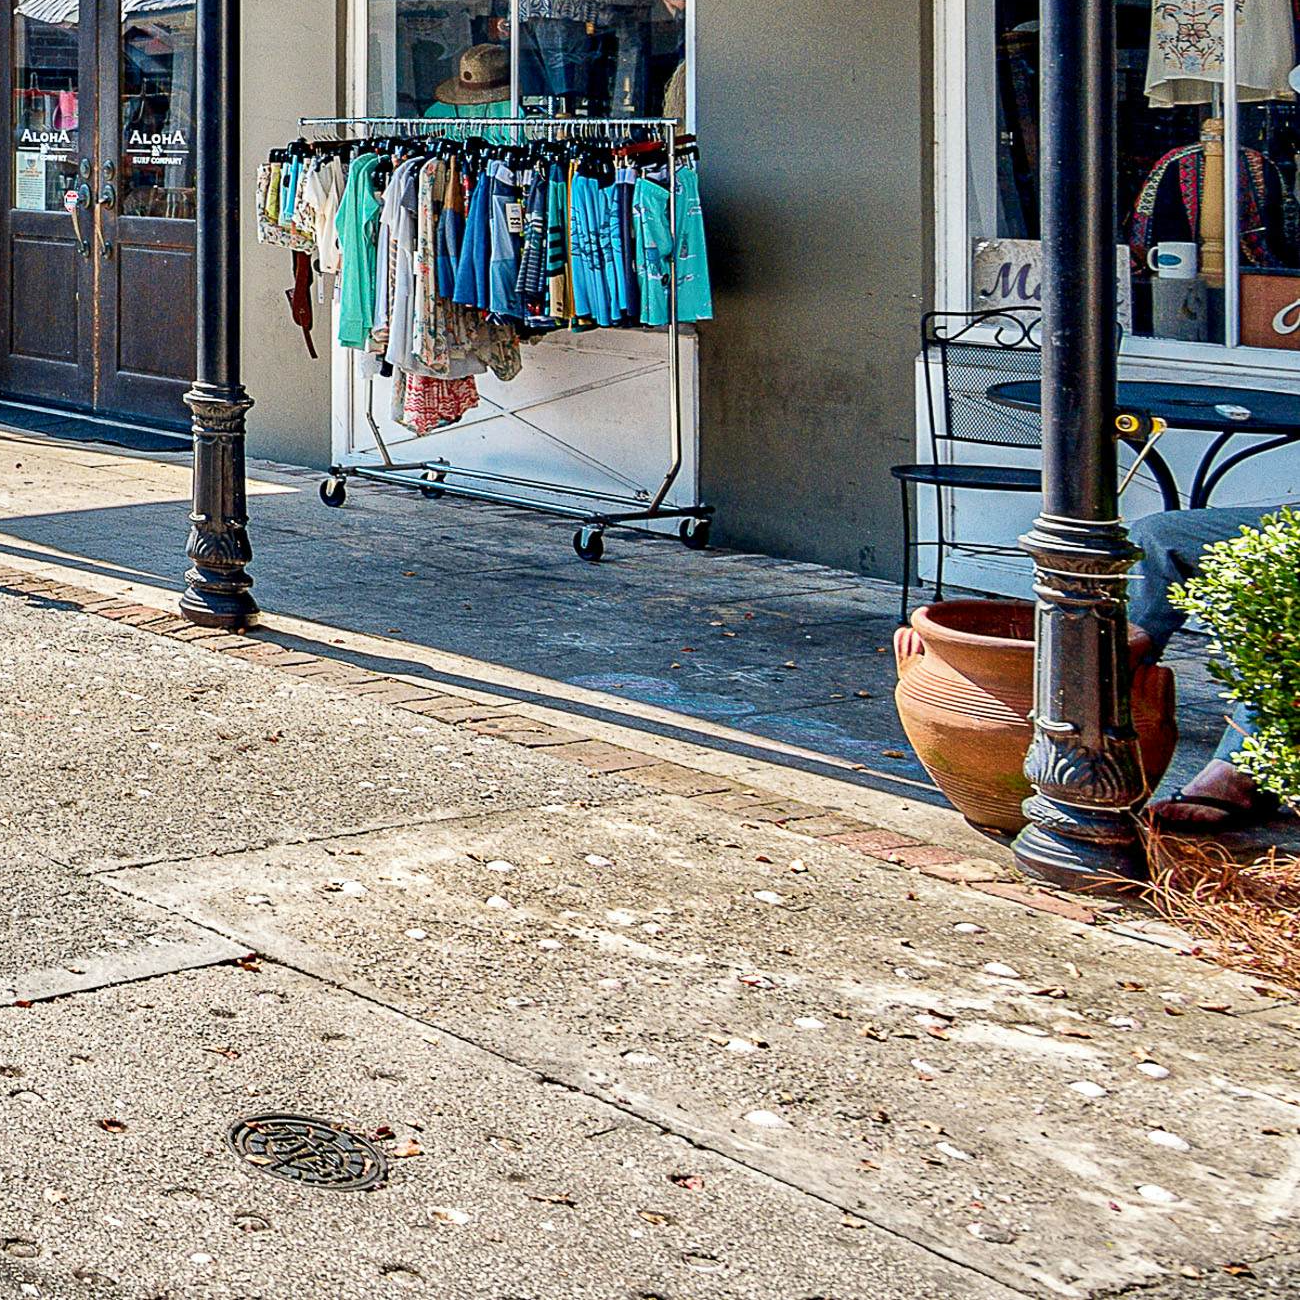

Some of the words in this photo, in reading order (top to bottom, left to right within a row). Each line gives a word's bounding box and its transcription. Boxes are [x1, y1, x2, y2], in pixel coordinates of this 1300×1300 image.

[20, 129, 70, 143] ALOHA
[129, 130, 186, 145] ALOHA
[150, 157, 183, 165] COMPANY
